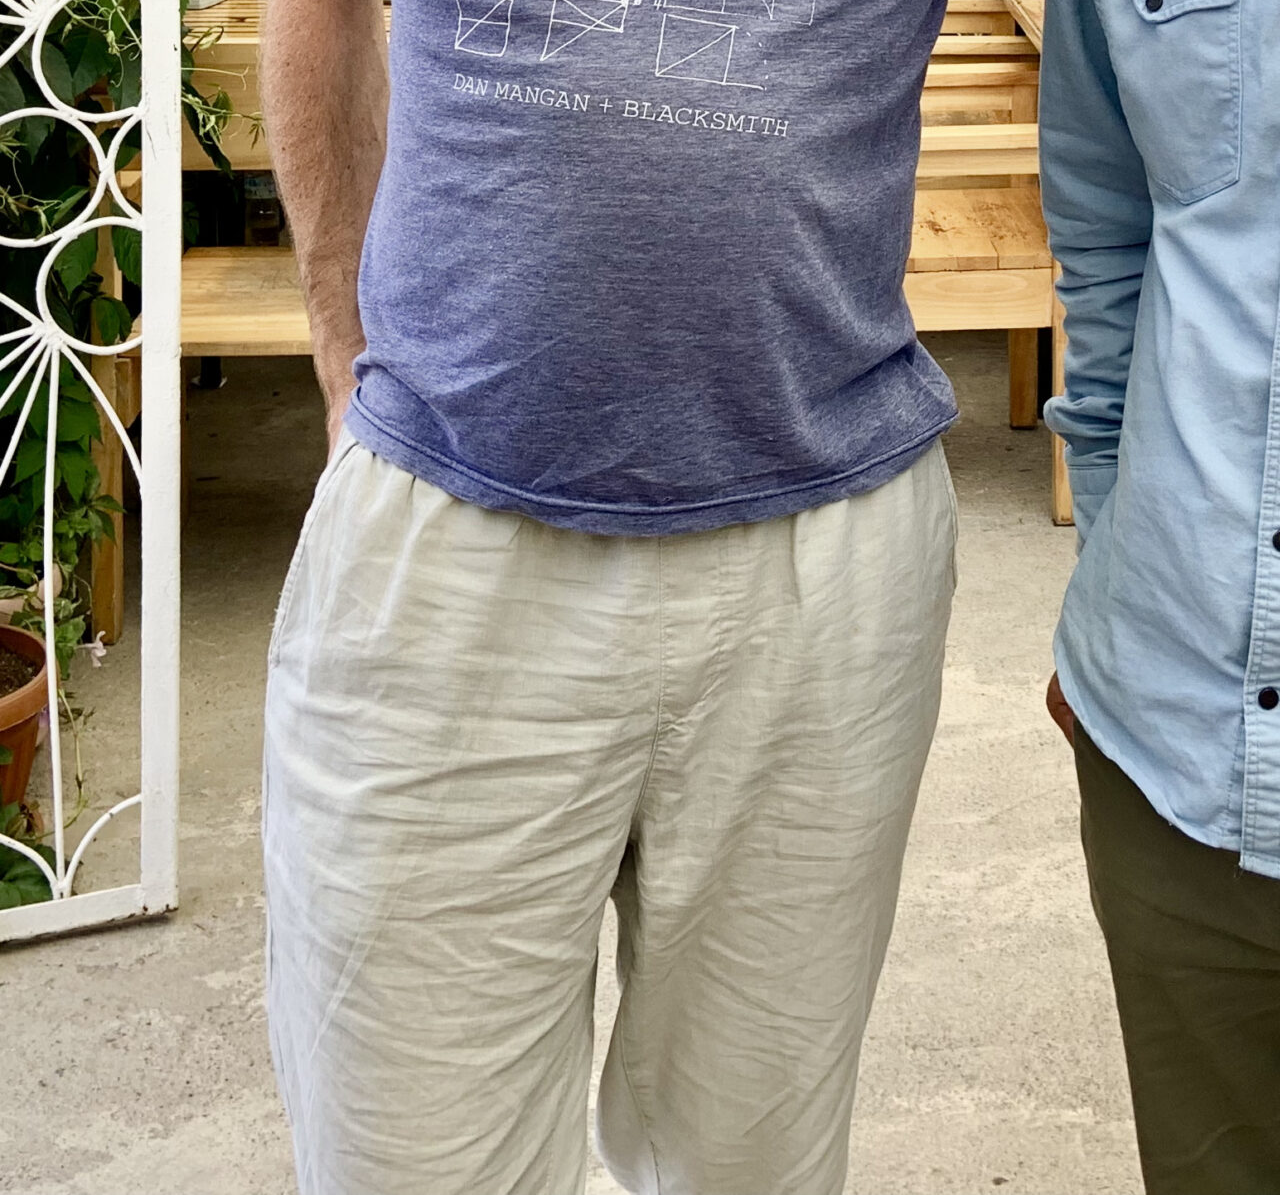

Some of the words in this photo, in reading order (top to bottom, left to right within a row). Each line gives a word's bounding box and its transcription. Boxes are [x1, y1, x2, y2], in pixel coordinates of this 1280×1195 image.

[453, 73, 489, 97] DAN
[494, 81, 591, 113] MANGAN
[623, 100, 790, 138] BLACKSMITH
